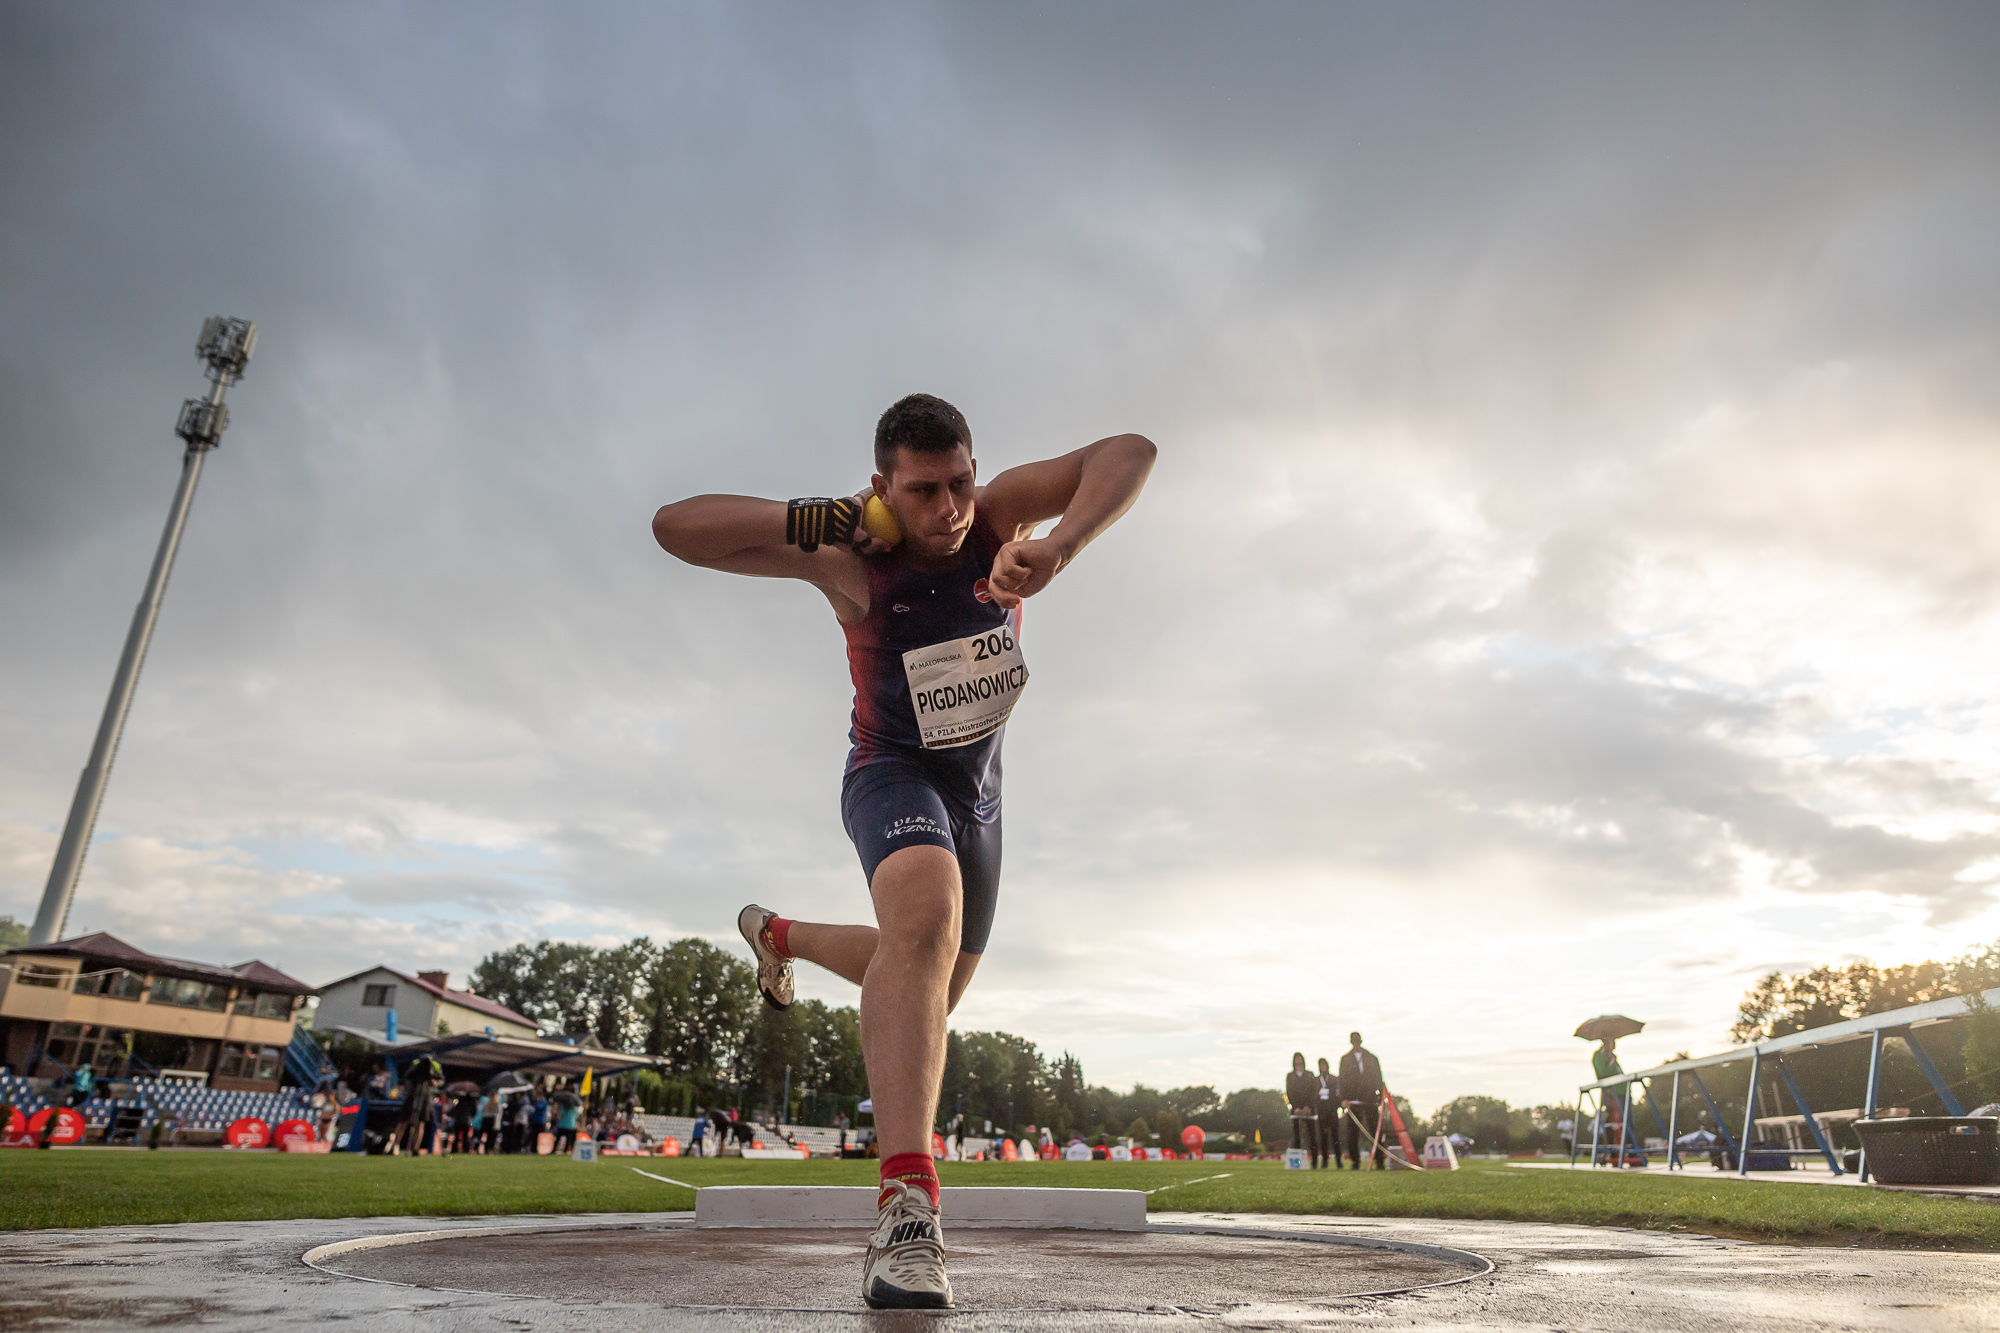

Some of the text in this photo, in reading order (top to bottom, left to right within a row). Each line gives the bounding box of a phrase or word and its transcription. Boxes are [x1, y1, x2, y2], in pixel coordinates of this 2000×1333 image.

[971, 629, 1014, 662] 206
[918, 653, 962, 669] MAŁOPOLSKA
[916, 665, 1025, 714] PIGDANOWICZ
[924, 731, 936, 739] 54.
[937, 727, 956, 737] PZLA
[958, 716, 998, 733] Mistrzostwa
[1428, 1143, 1446, 1157] 11
